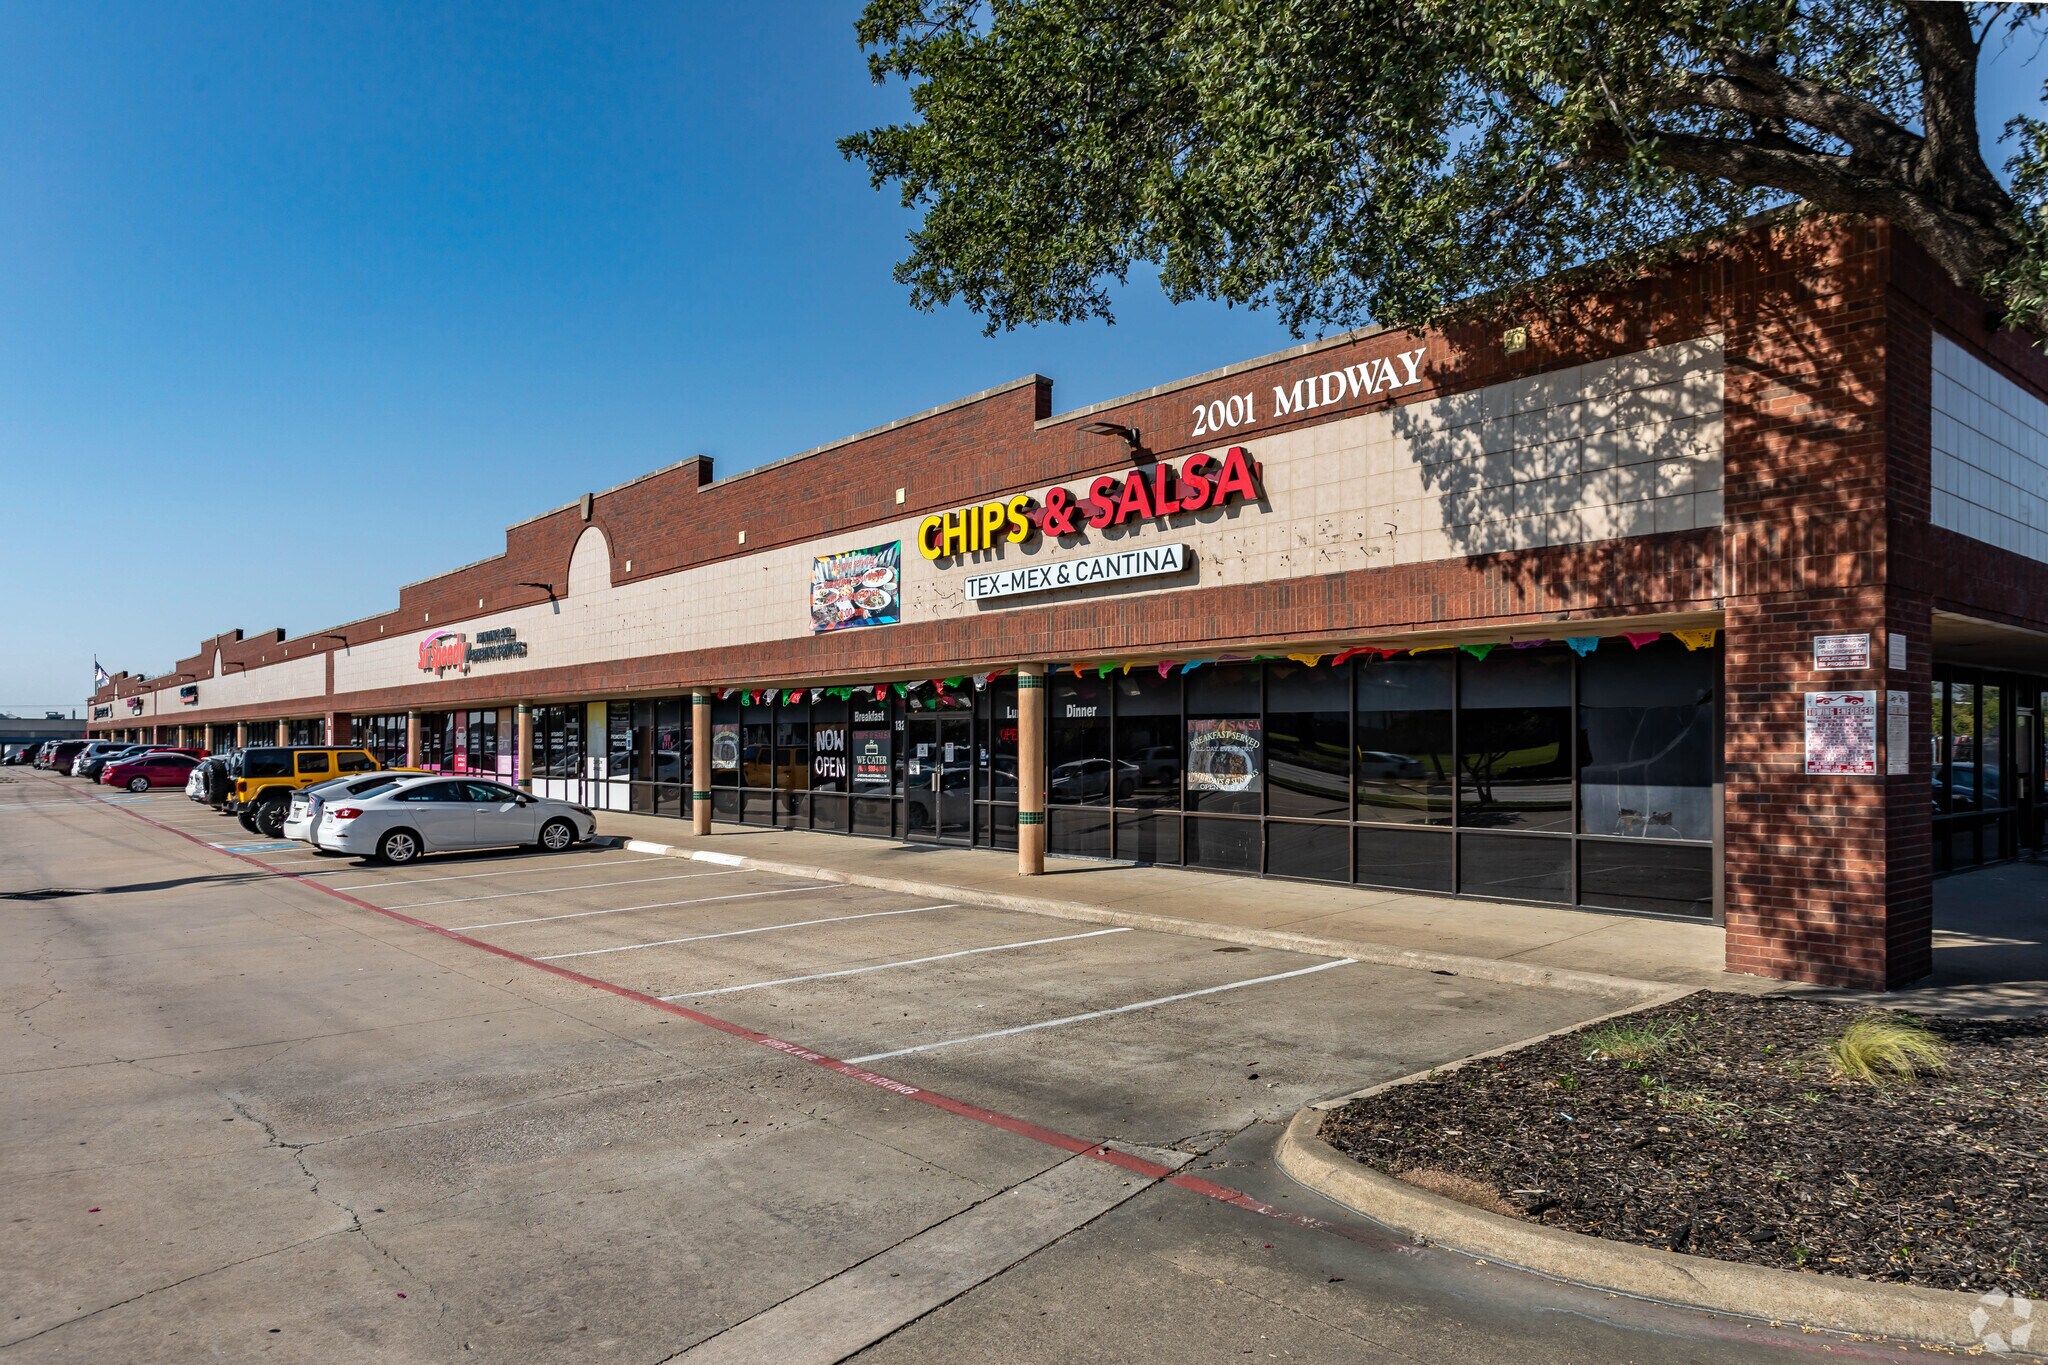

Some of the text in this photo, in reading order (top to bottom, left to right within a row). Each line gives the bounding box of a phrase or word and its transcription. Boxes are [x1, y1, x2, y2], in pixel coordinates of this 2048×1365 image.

[1191, 346, 1427, 437] 2001 MIDWAY
[917, 445, 1257, 560] CHIPS & SALSA
[967, 547, 1178, 597] TEX-MEX & CANTINA
[430, 633, 467, 675] Speedy
[854, 710, 884, 722] Breakfast
[1066, 703, 1097, 717] Dinner
[1001, 727, 1019, 742] OPE
[1229, 719, 1260, 732] SALSA
[816, 729, 845, 752] NOW
[1189, 730, 1260, 749] BREAKFAST SERVED
[815, 755, 846, 778] OPEN
[856, 755, 887, 765] WE CATER
[759, 1039, 825, 1061] FIRE LANE
[854, 1072, 919, 1095] PARKING
